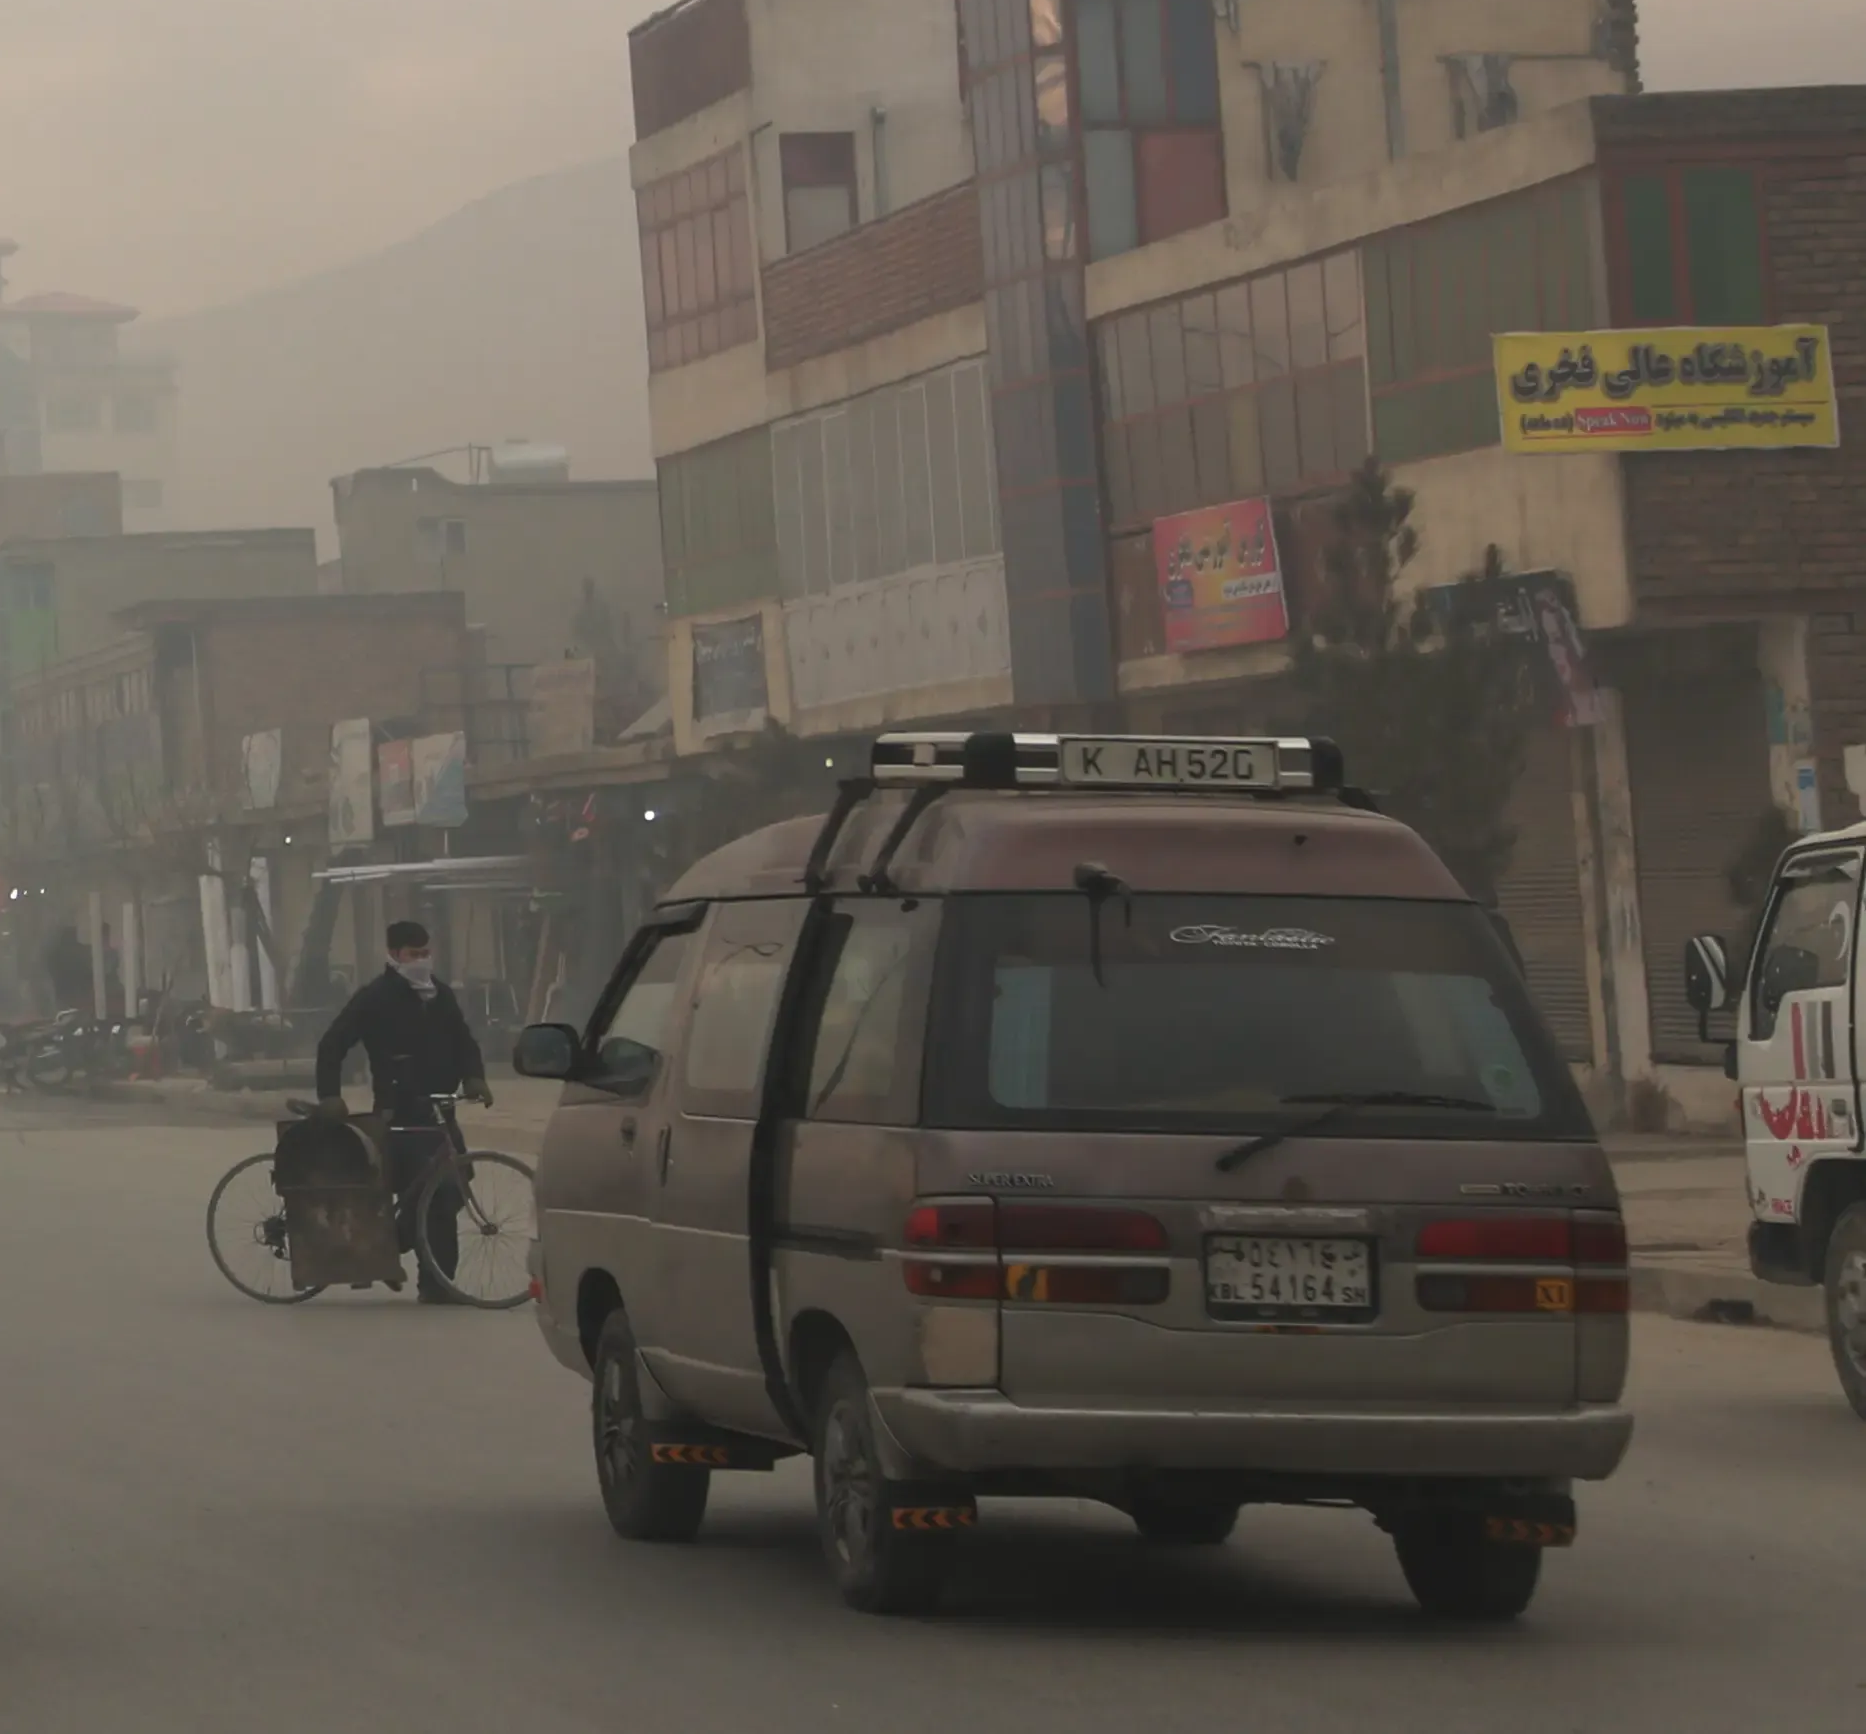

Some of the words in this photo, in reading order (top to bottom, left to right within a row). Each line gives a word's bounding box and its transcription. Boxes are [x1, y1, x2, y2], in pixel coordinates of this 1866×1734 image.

[1510, 345, 1597, 402] فخری
[1602, 344, 1675, 400] عالی
[1679, 336, 1819, 397] آموزشگاه
[1577, 412, 1618, 432] Speak
[1620, 411, 1650, 426] Now
[1081, 747, 1105, 776] K
[1133, 748, 1178, 778] AH
[1251, 1273, 1336, 1302] 54164
